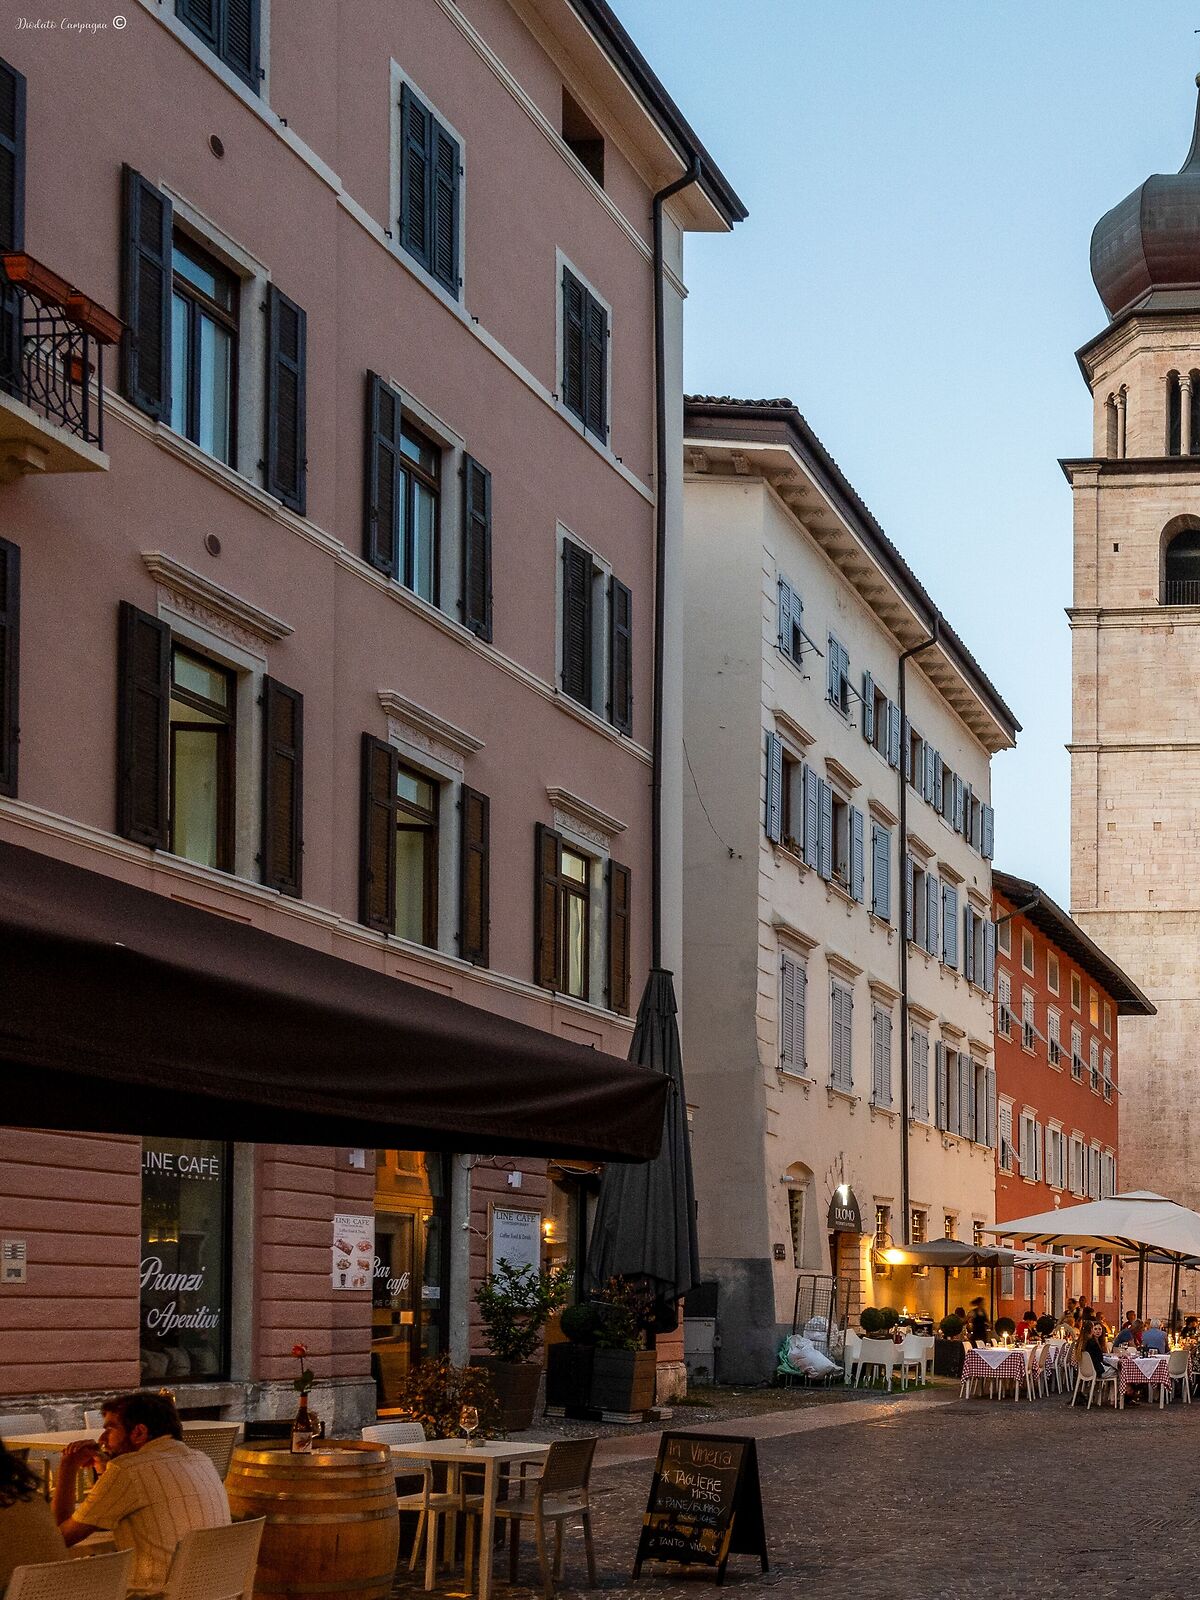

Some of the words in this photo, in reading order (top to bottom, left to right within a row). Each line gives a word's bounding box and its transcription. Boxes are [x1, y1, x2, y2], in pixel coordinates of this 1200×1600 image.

[178, 1154, 219, 1175] CAFÈ
[496, 1211, 513, 1221] LINE
[140, 1256, 206, 1291] Pranzi
[373, 1256, 391, 1278] Bar
[147, 1301, 221, 1337] Aperitivi
[691, 1488, 721, 1502] MISTO
[659, 1537, 685, 1548] TANTO
